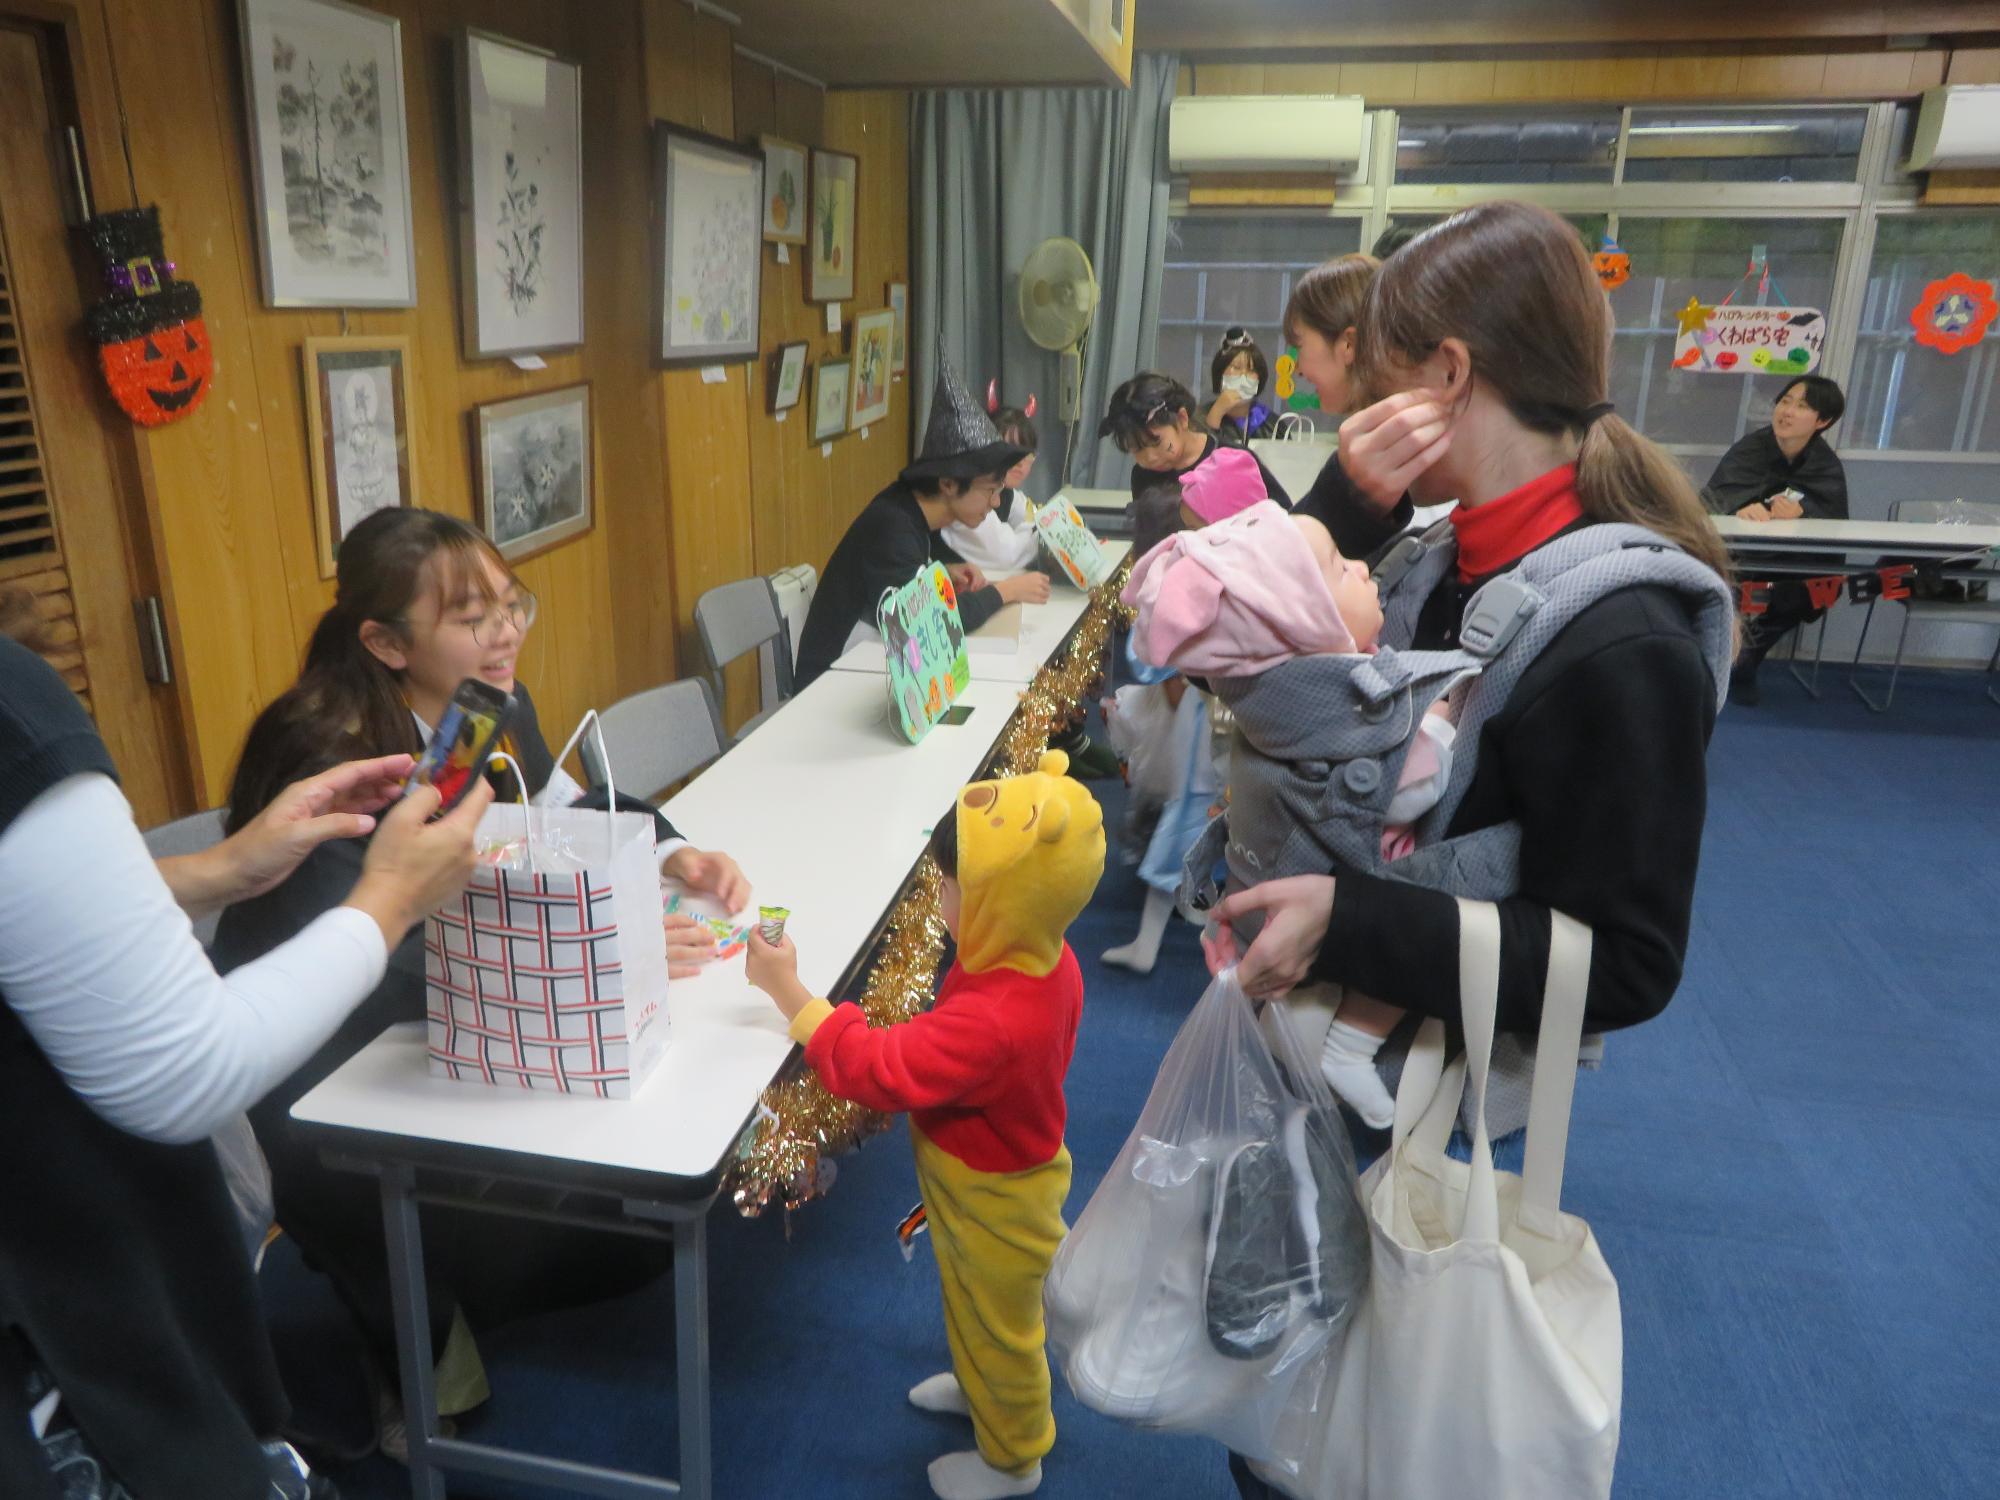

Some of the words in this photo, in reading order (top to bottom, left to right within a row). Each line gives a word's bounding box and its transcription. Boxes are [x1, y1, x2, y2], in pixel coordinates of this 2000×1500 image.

[1718, 325, 1790, 347] くわばら宅
